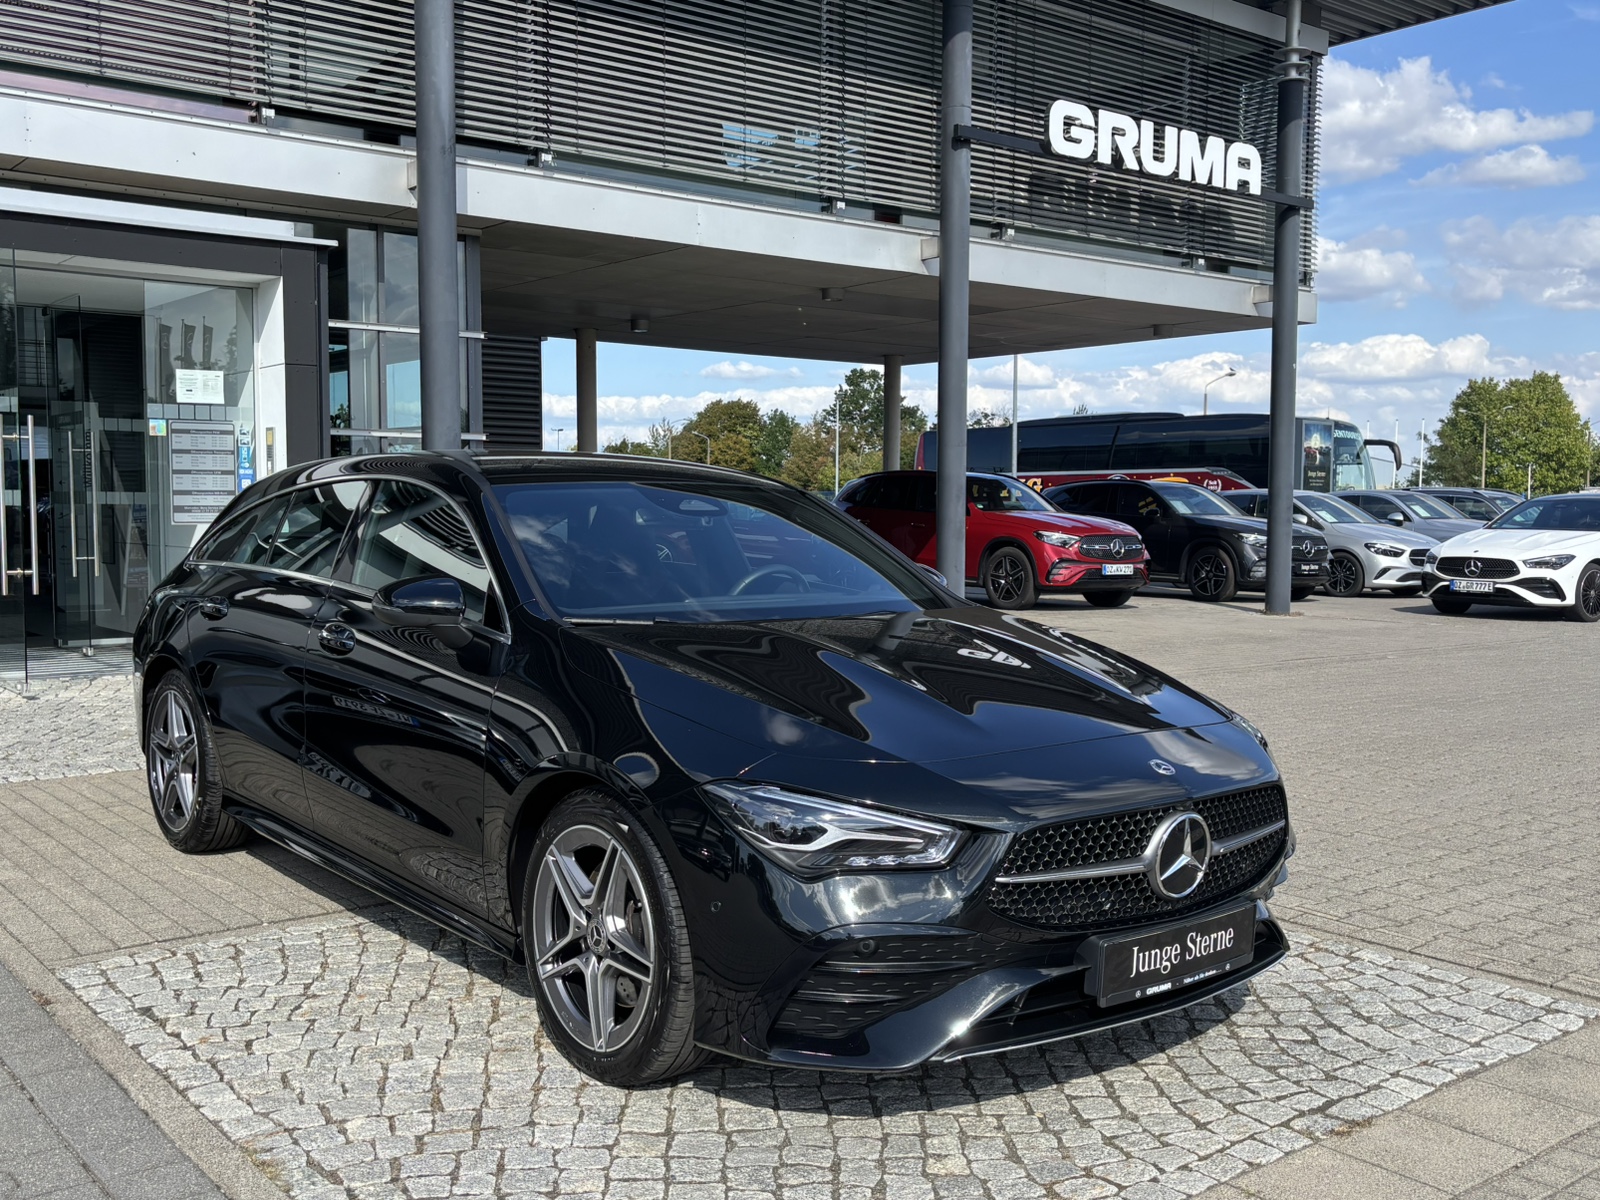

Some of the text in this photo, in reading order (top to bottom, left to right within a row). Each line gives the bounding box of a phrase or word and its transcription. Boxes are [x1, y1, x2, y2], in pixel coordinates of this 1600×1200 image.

[1047, 99, 1262, 196] GRUMA
[1130, 928, 1234, 977] Junge Sterne
[1146, 983, 1172, 995] GRUMA
